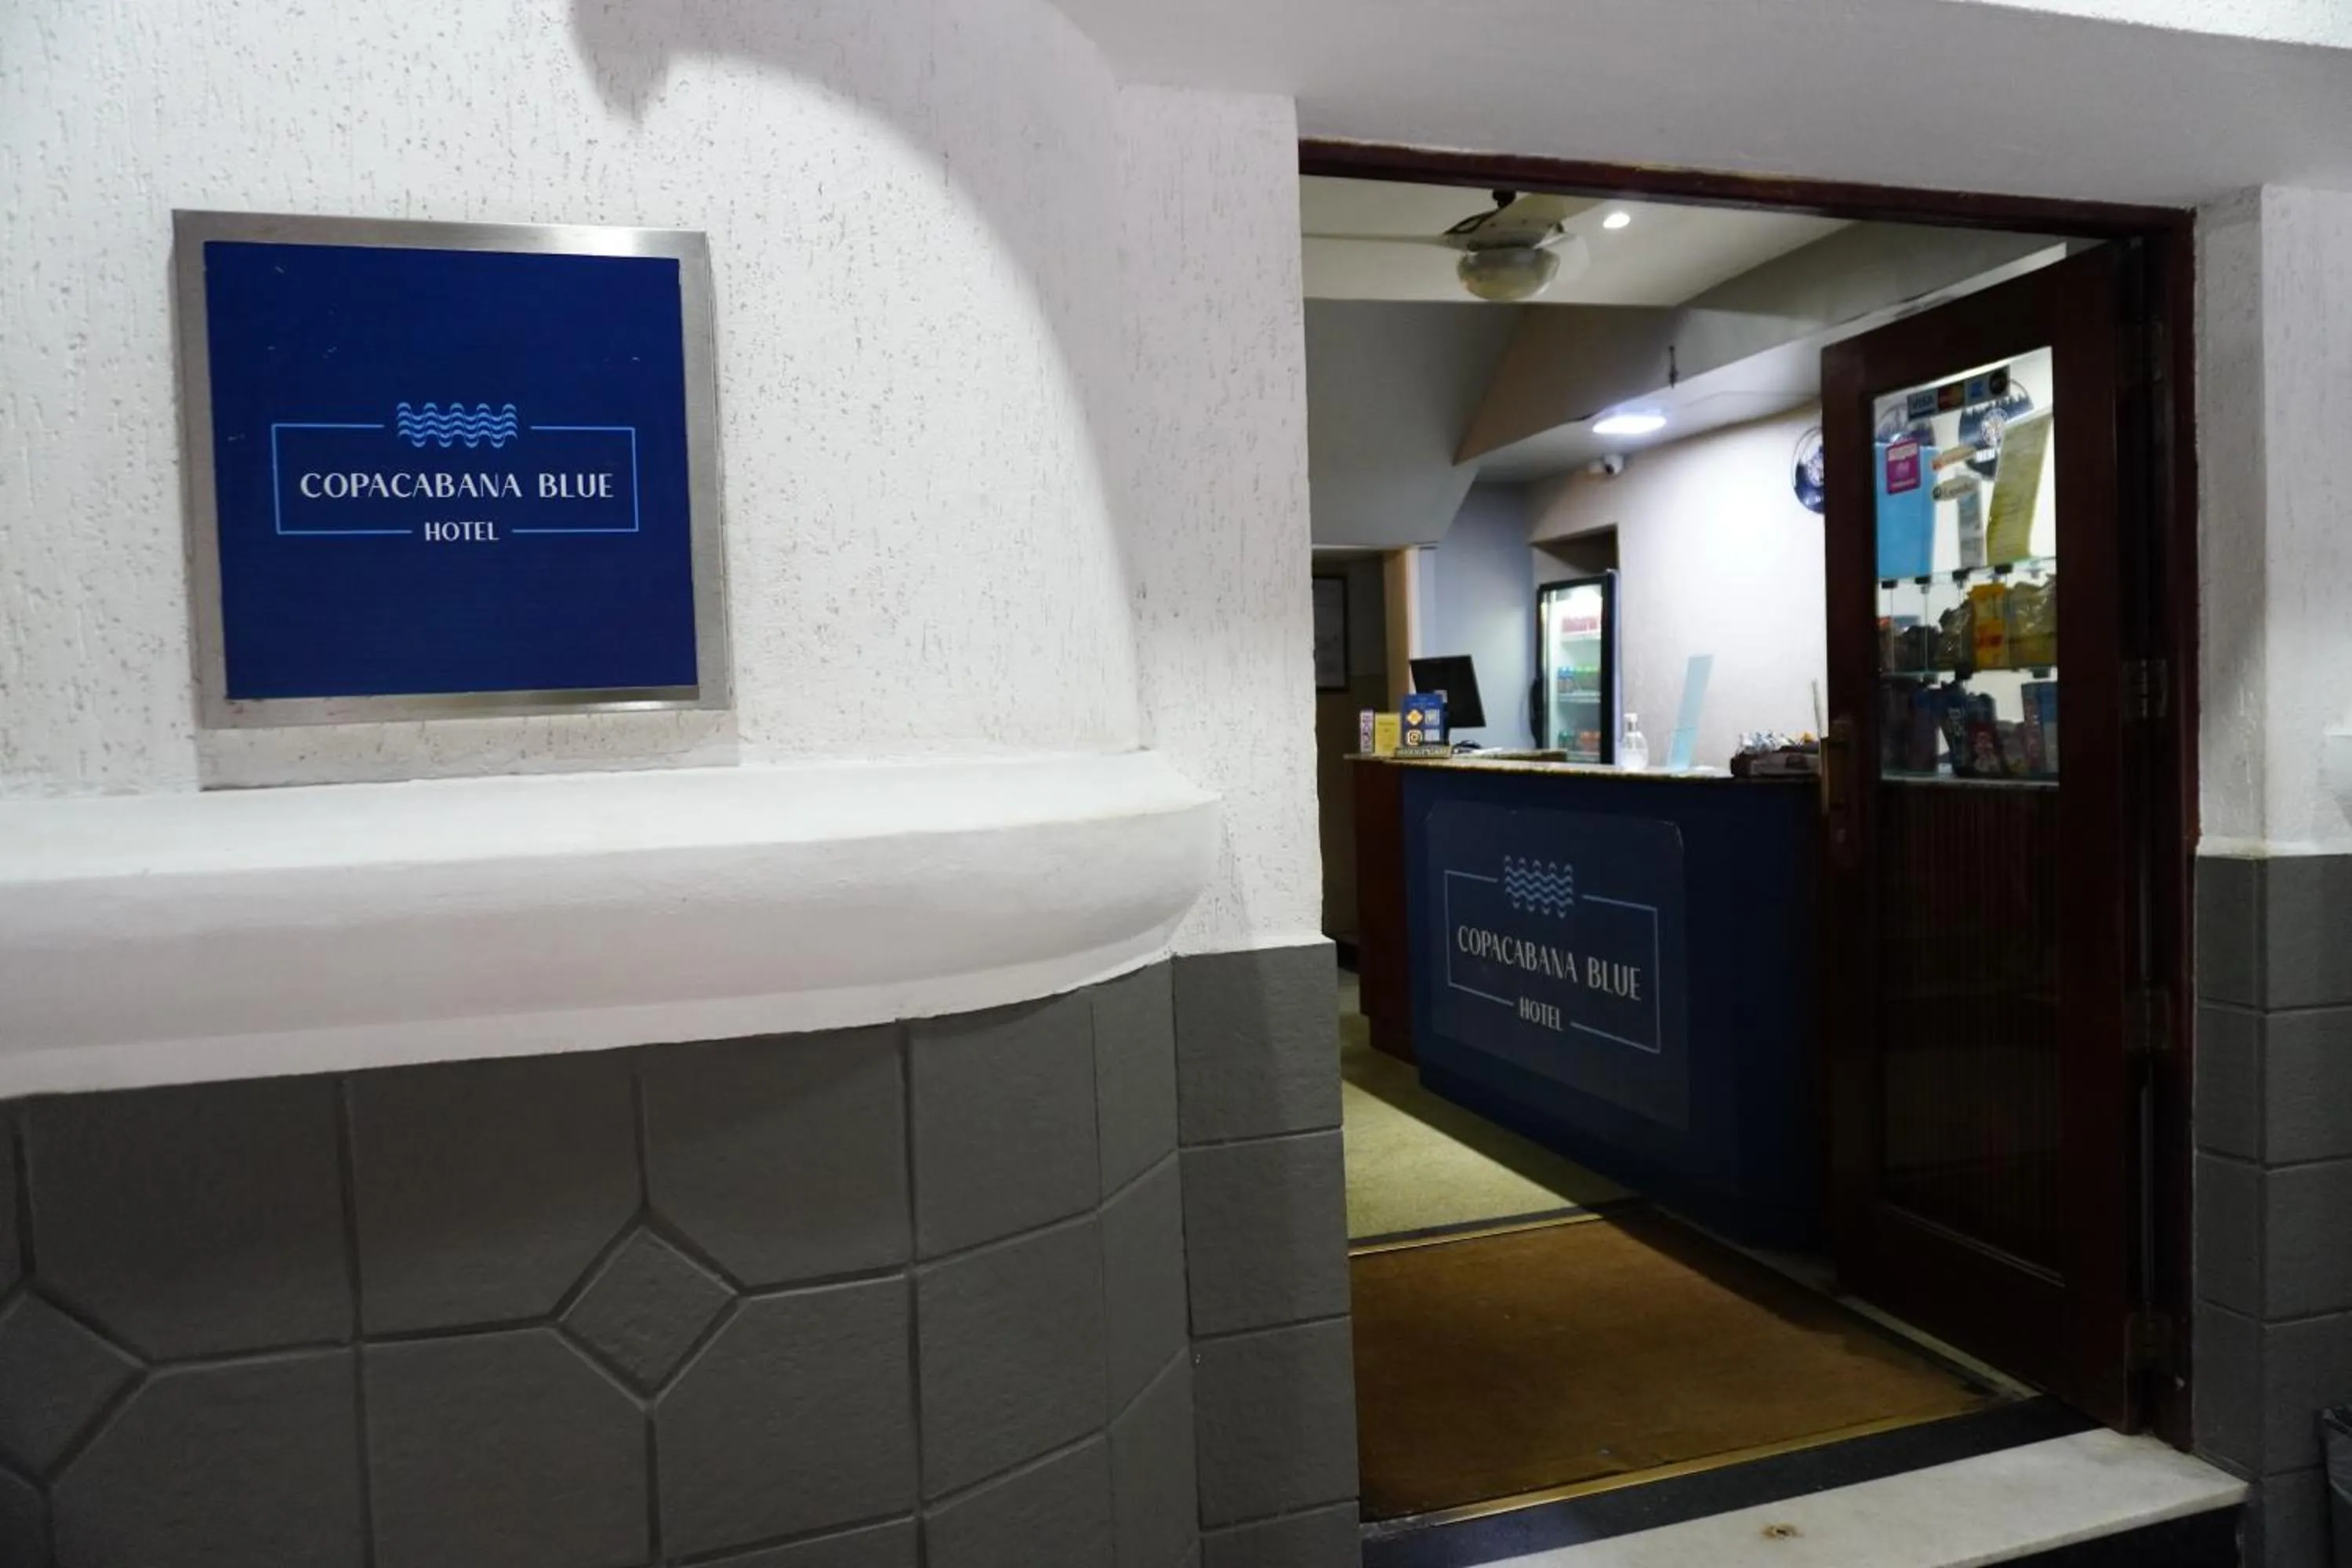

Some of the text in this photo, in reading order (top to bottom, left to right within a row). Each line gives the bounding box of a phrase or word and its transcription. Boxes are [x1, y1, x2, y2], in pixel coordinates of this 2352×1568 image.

[300, 473, 614, 498] COPACABANA BLUE
[424, 521, 499, 541] HOTEL
[1457, 925, 1641, 1000] COPACABANA BLUE
[1519, 996, 1563, 1031] HOTEL
